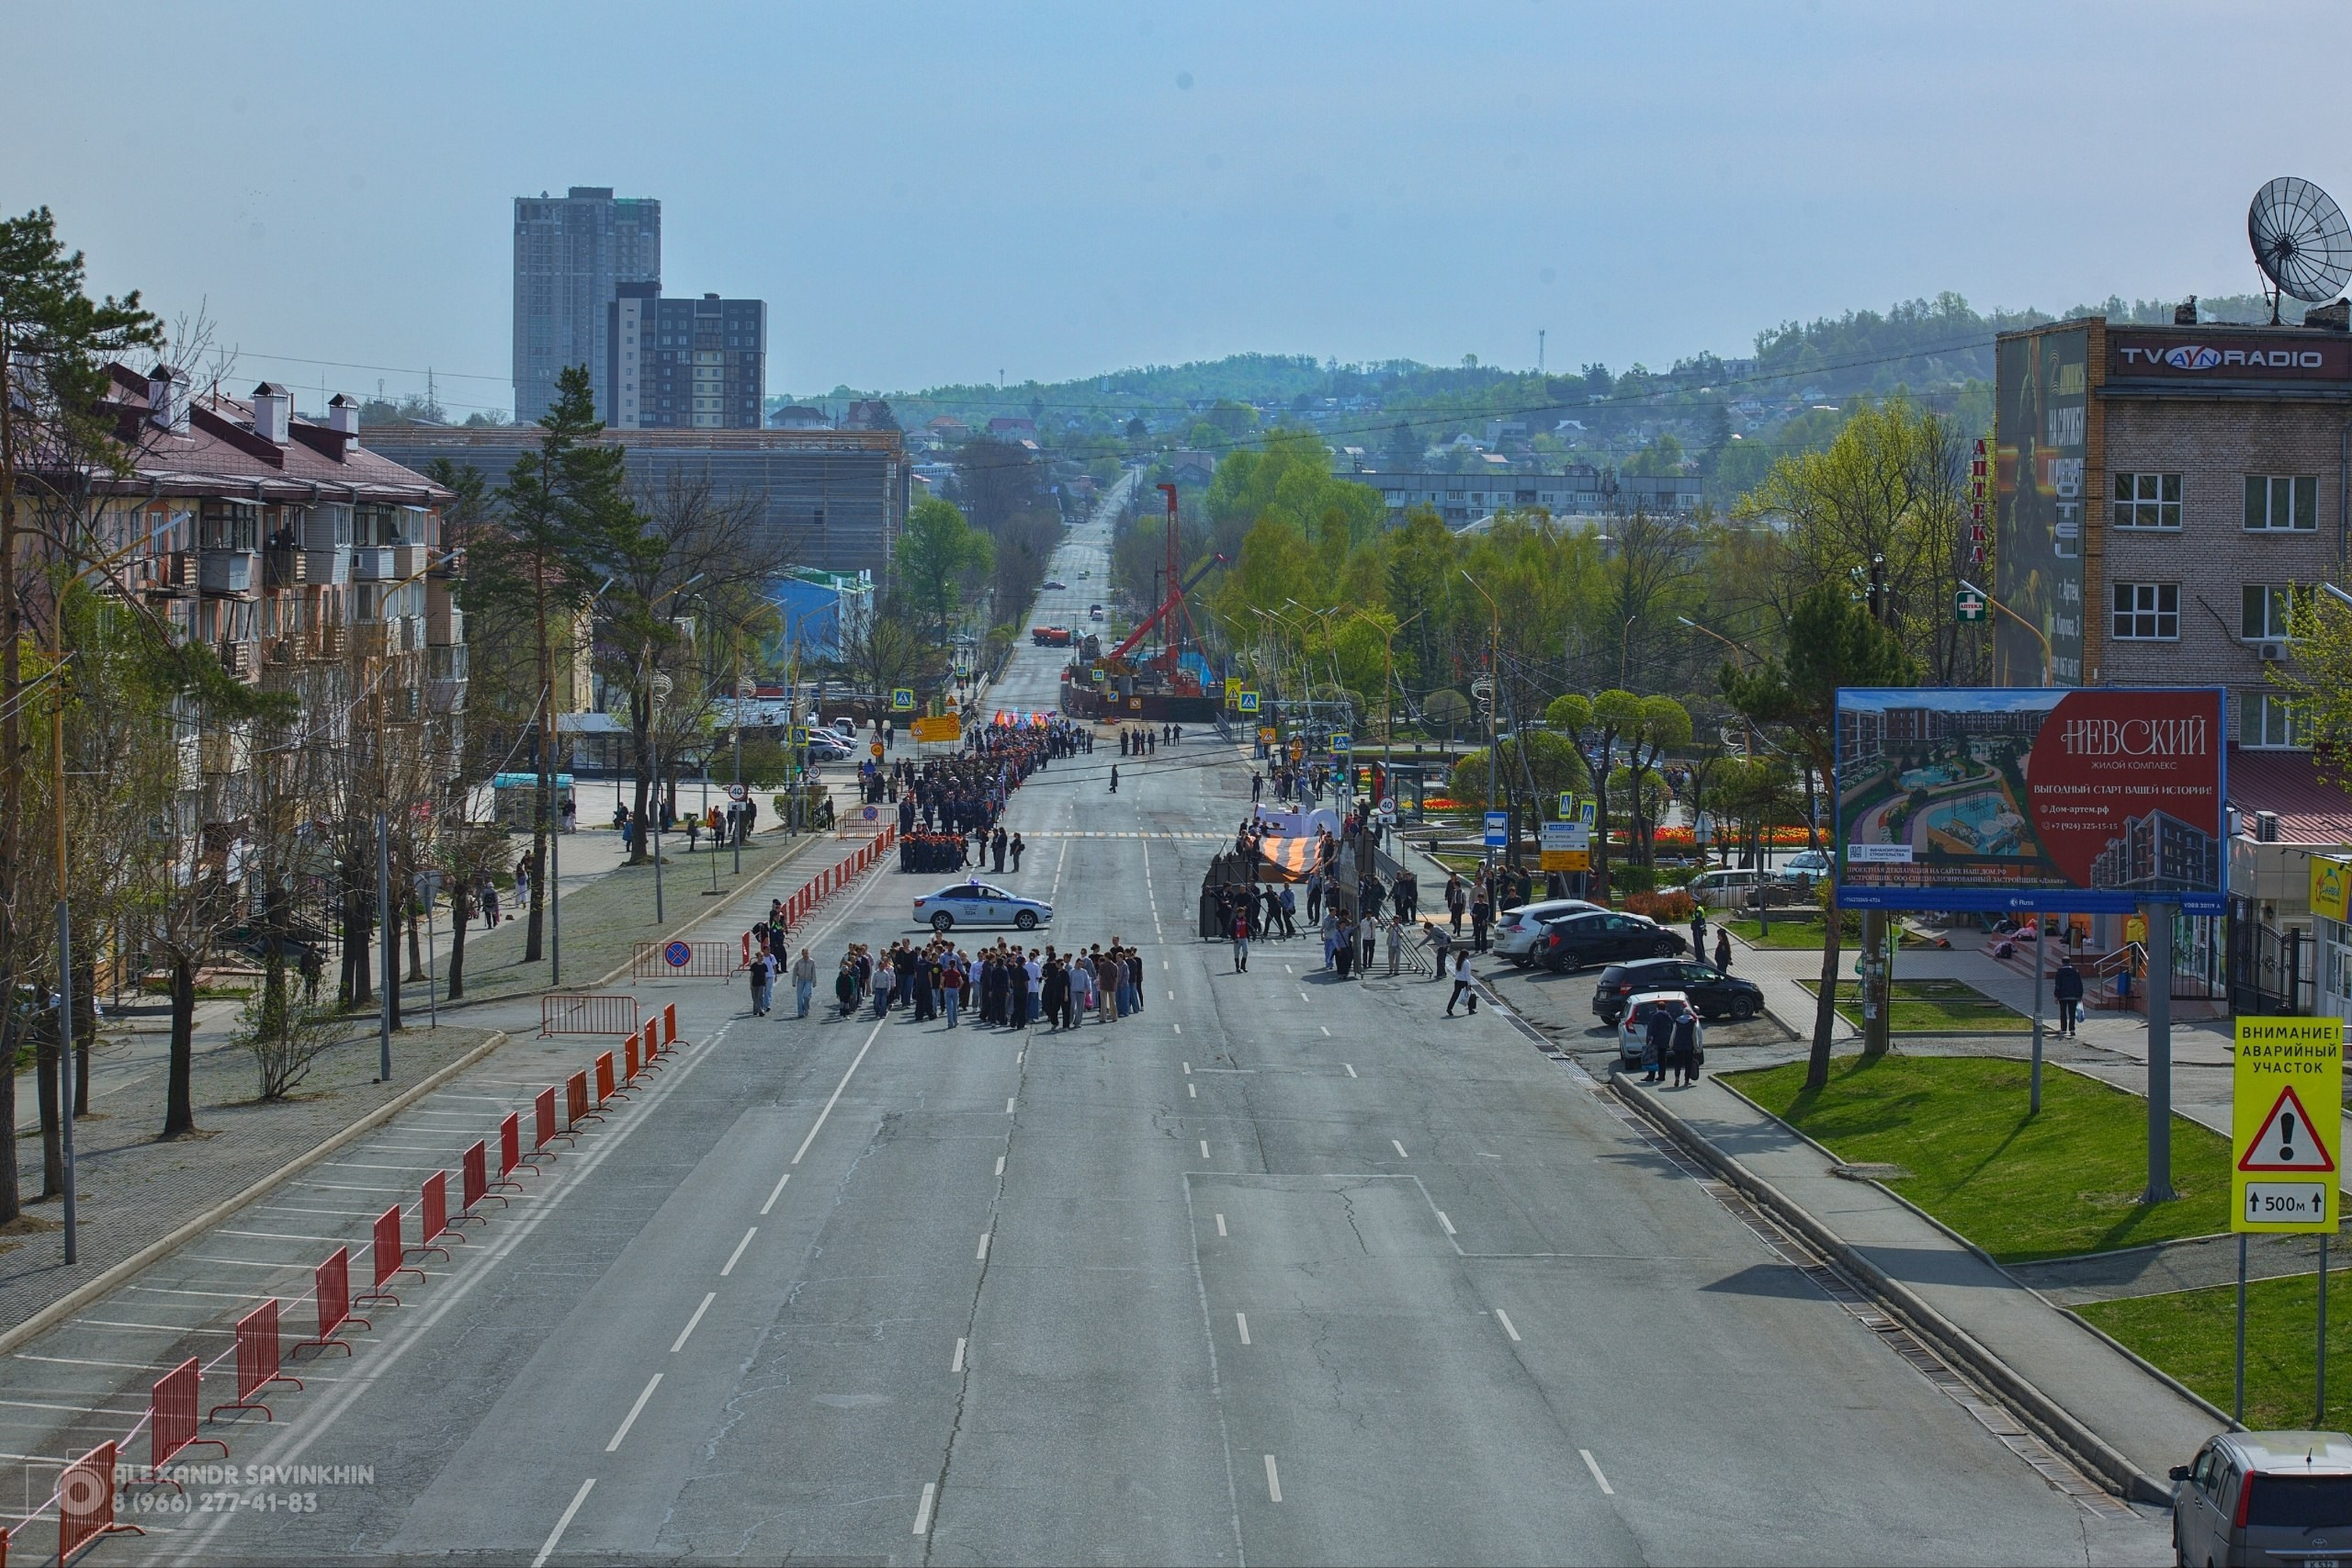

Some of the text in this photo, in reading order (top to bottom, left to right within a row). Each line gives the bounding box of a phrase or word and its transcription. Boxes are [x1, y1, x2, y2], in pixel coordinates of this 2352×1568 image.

[2120, 348, 2164, 364] TV
[2223, 350, 2323, 368] RADIO
[2048, 406, 2086, 446] НА СЛУЖБУ
[1970, 438, 1986, 564] АПТЕКА
[2056, 612, 2075, 641] Кирова,
[2061, 715, 2206, 755] НЕВСКИЙ
[2091, 761, 2177, 770] ЖИЛОЙ КОМПЛЕКС
[730, 787, 742, 795] 40
[2033, 784, 2212, 795] ВЫГОДНЫЙ СТАРТ ВАШЕЙ ИСТОРИИ!
[1381, 801, 1393, 809] 40
[2049, 805, 2109, 816] Дом-артем.рф
[2051, 822, 2118, 830] +7 (924) 325-15-15
[1908, 874, 1992, 883] СПЕЦИАЛИЗИРОВАННЫЙ
[1992, 875, 2038, 884] ЗАСТРОЙЩИК
[2242, 1026, 2340, 1040] ВНИМАНИЕ!
[2242, 1042, 2337, 1057] АВАРИЙНЫЙ
[2253, 1061, 2324, 1074] УЧАСТОК
[2265, 1197, 2305, 1213] 500м
